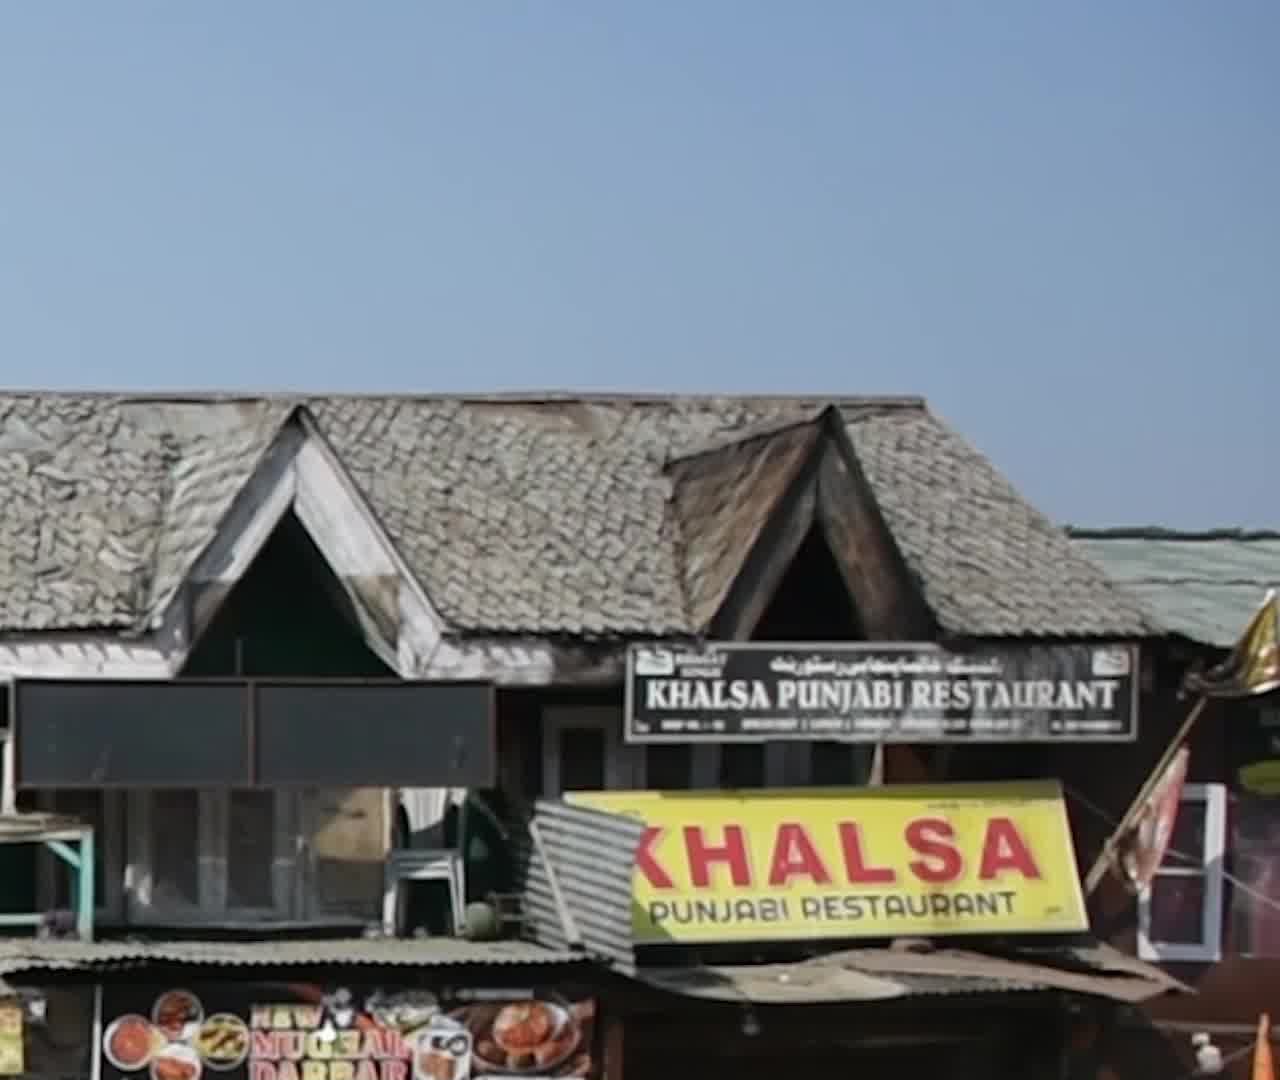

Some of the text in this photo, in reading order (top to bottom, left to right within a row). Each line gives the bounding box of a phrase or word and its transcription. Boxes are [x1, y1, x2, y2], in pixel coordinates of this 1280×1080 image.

[646, 678, 1121, 715] KHALSA PUNJABI RESTAURANT
[634, 817, 1043, 890] KHALSA
[650, 891, 1017, 926] PUNJABI RESTAURANT
[251, 1005, 323, 1028] NEW
